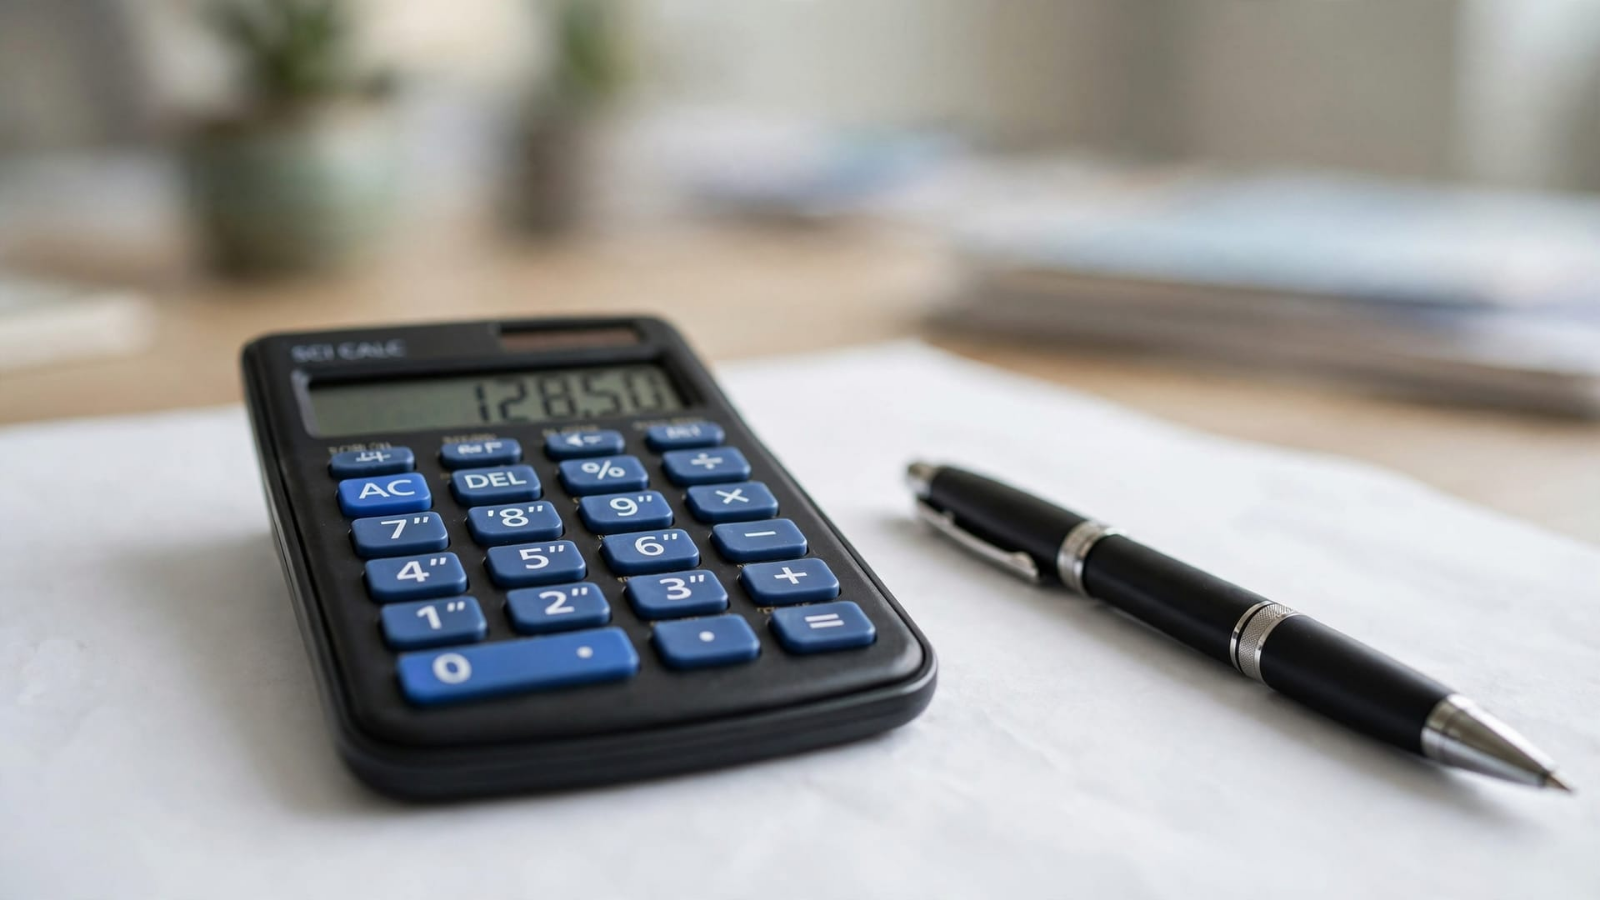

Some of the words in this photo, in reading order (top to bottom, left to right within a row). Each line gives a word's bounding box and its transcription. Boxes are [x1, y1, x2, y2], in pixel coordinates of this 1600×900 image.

[337, 338, 406, 361] CALC
[474, 370, 667, 421] 128.50
[359, 480, 415, 499] AC
[465, 472, 526, 488] DEL
[434, 654, 471, 683] 0
